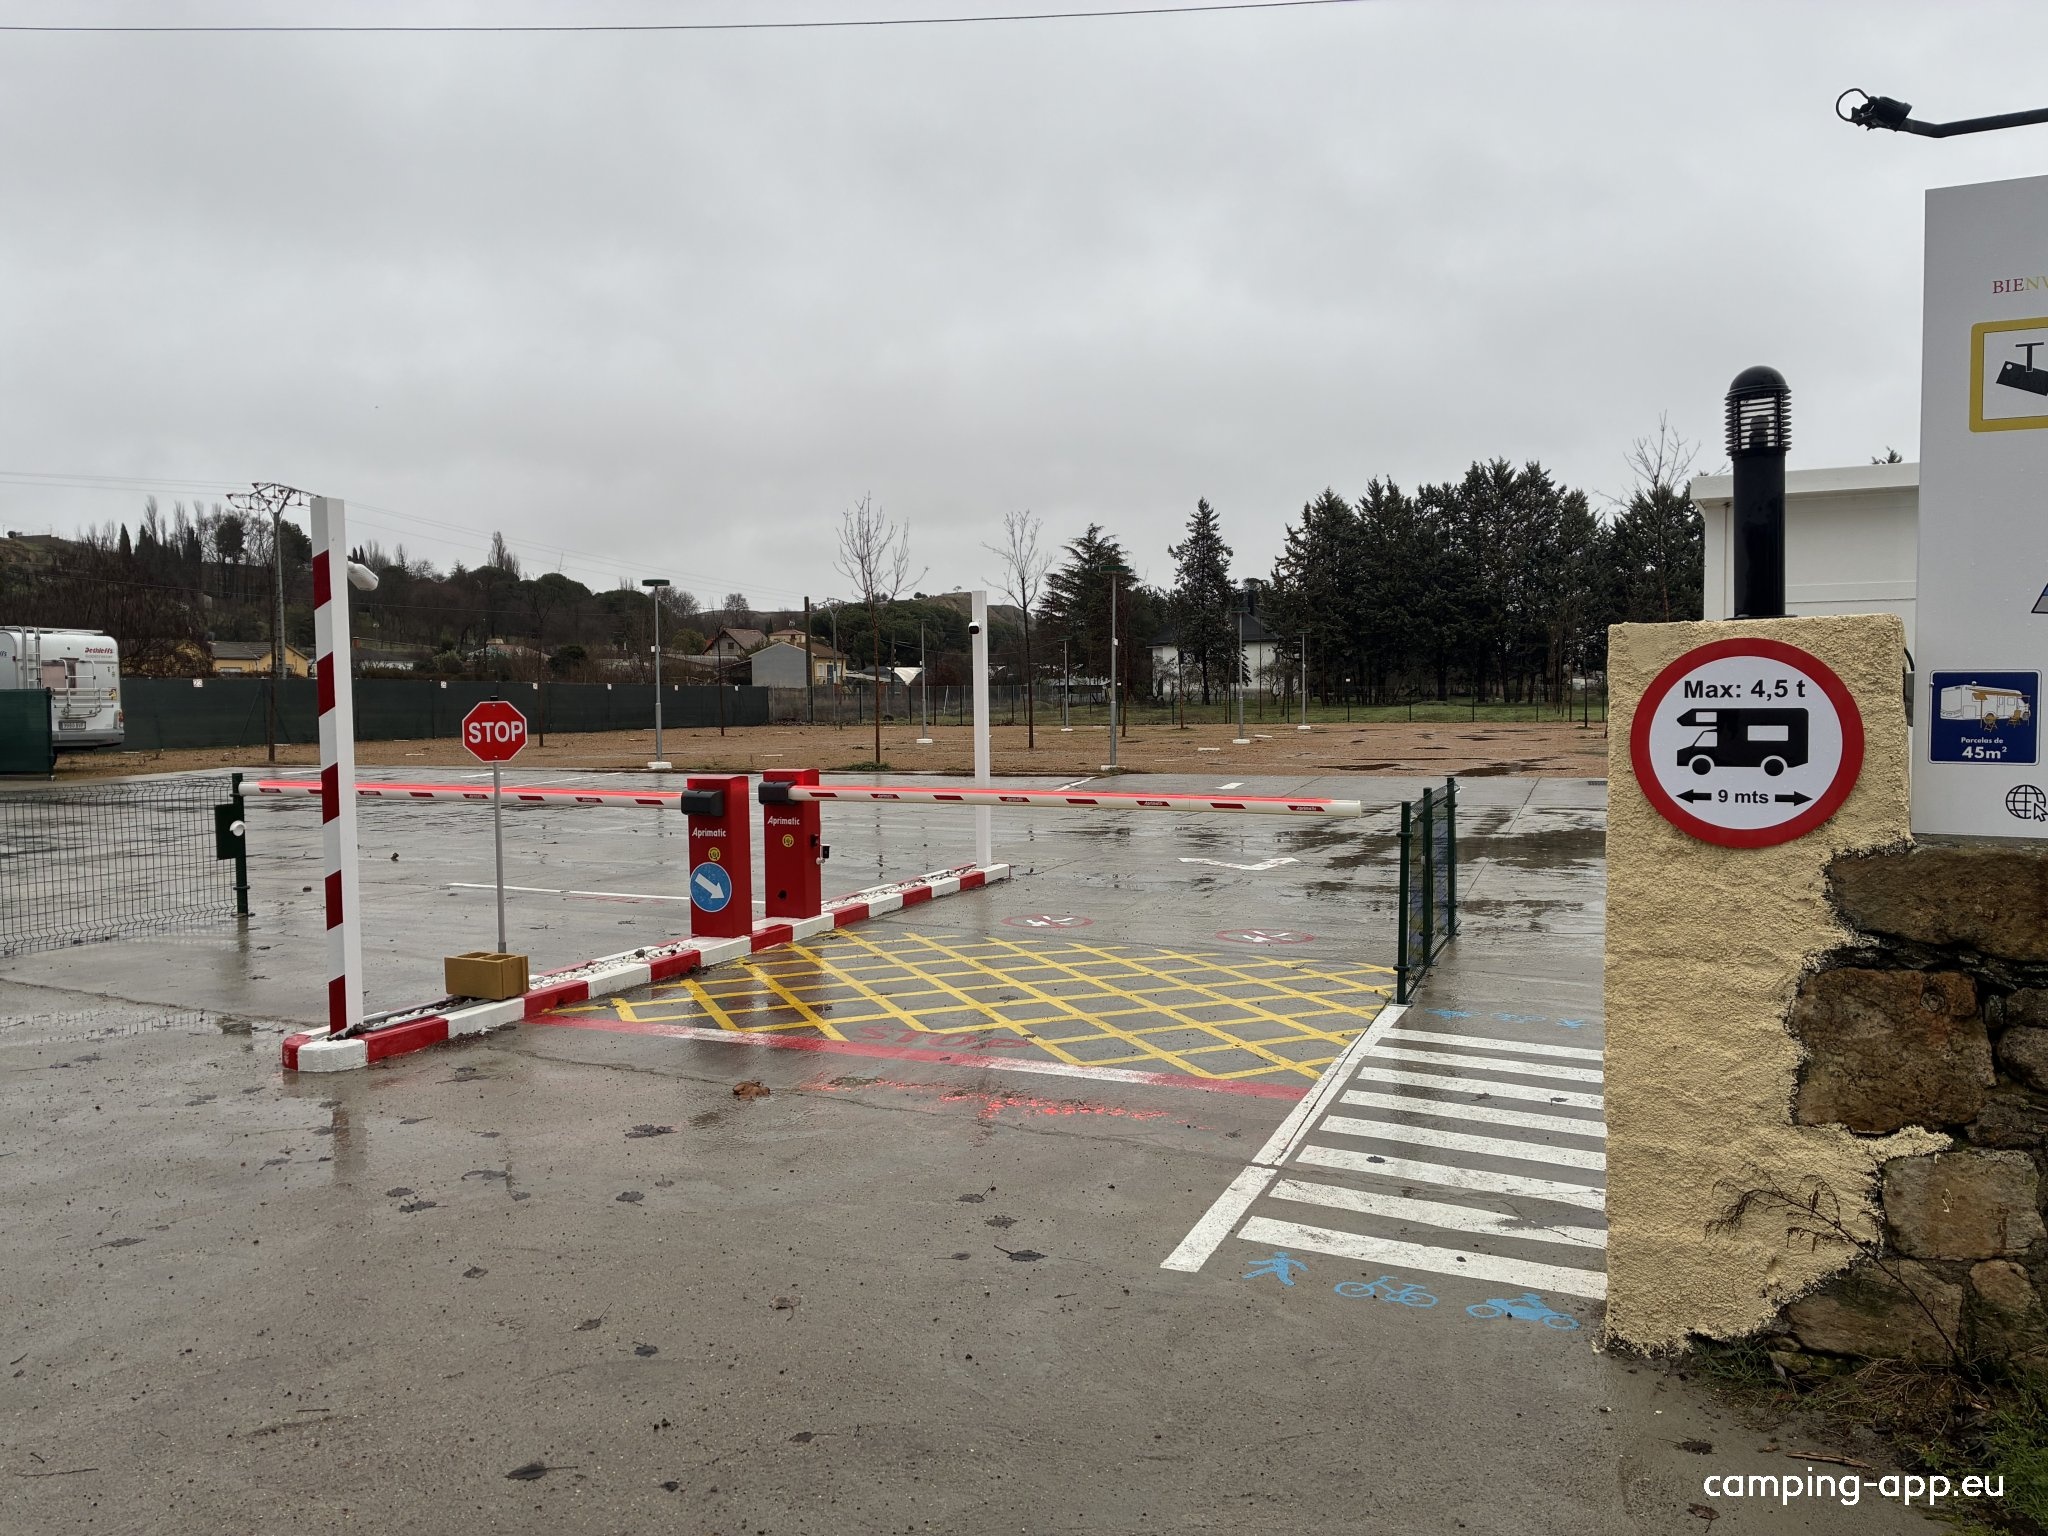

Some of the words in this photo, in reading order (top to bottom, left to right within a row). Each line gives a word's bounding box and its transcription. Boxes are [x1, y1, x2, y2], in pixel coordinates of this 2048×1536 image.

[1684, 679, 1742, 698] Max:
[1750, 679, 1789, 702] 4,5
[1796, 680, 1806, 698] t
[468, 720, 524, 744] STOP
[1960, 736, 1992, 744] Parcelas
[1994, 736, 2004, 744] de
[1717, 789, 1729, 803] 9
[1734, 789, 1769, 804] mts
[767, 815, 801, 826] Aprimatic
[691, 826, 727, 838] Aprimatic
[855, 1025, 1033, 1051] STOP
